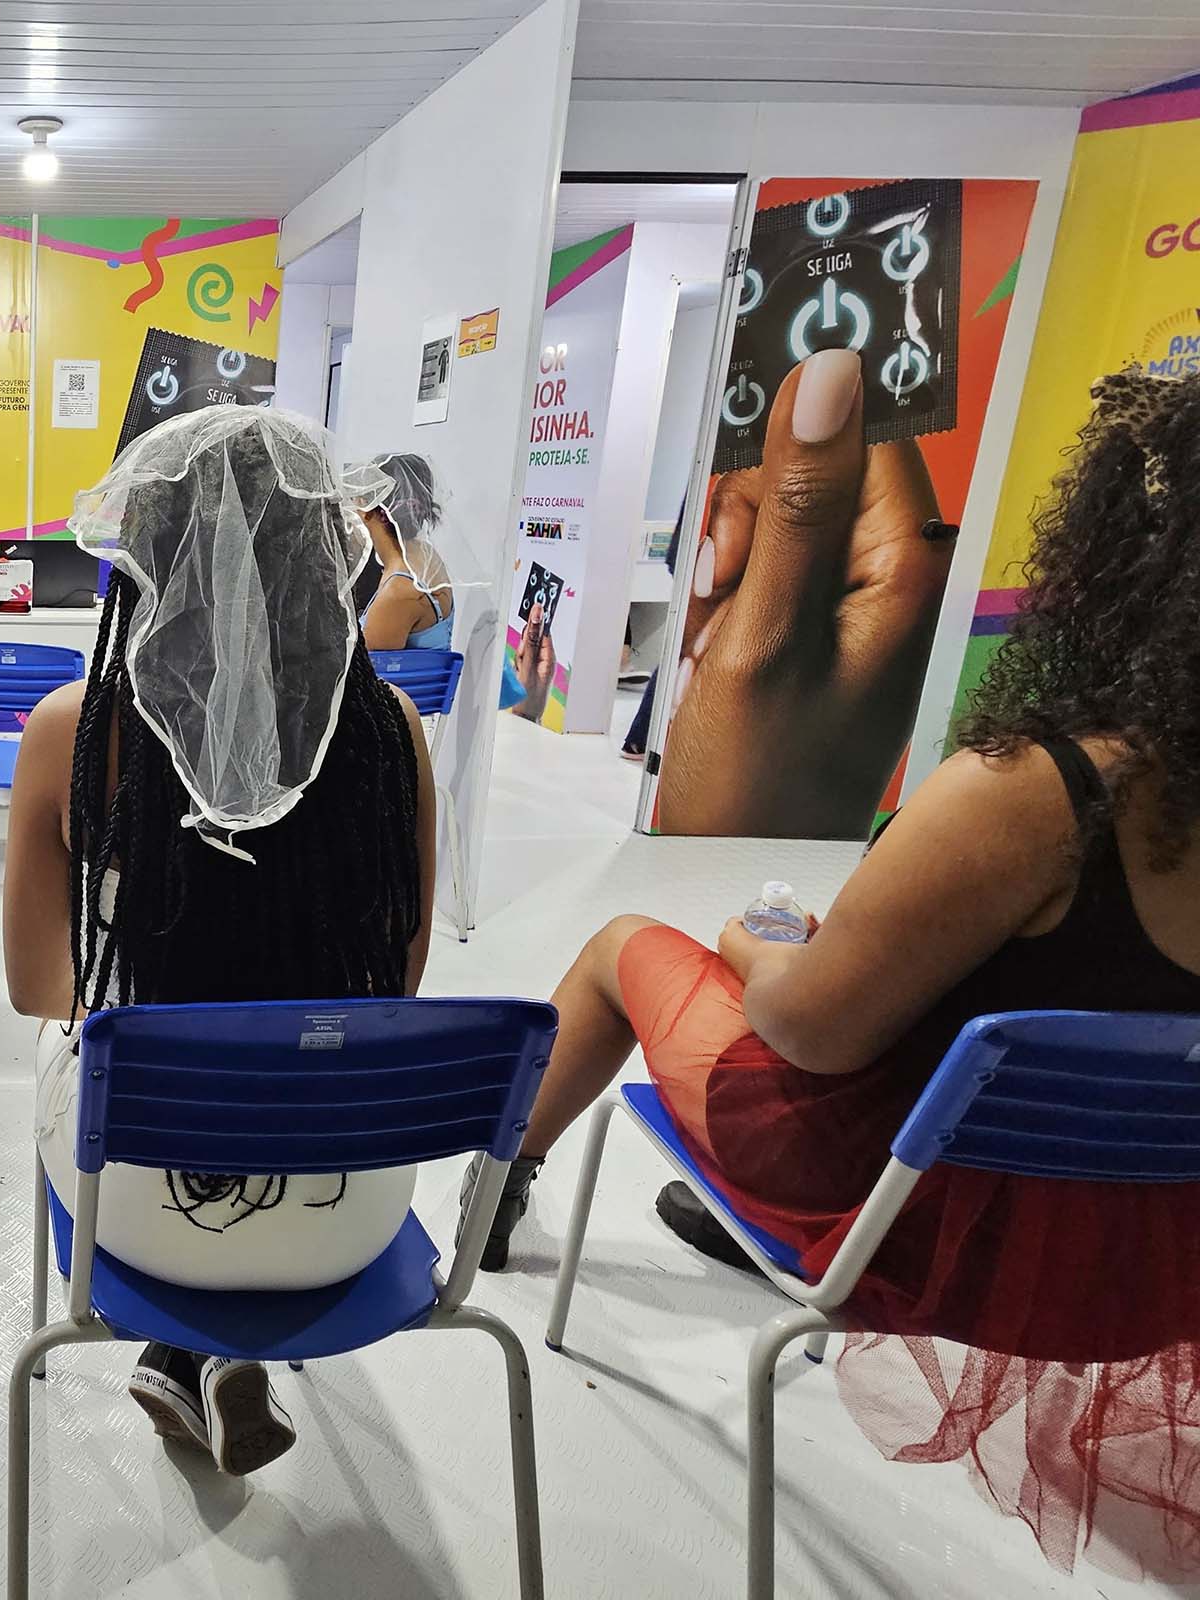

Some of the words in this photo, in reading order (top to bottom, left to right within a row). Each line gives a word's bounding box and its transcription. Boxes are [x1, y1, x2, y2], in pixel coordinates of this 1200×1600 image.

[807, 258, 823, 277] SE
[826, 252, 852, 273] LIGA
[206, 388, 219, 402] SE
[530, 410, 595, 443] ISINHA.
[529, 448, 590, 467] PROTEJA-SE.
[533, 496, 544, 507] FAZ
[545, 497, 551, 507] O
[551, 497, 584, 508] CARNAVAL
